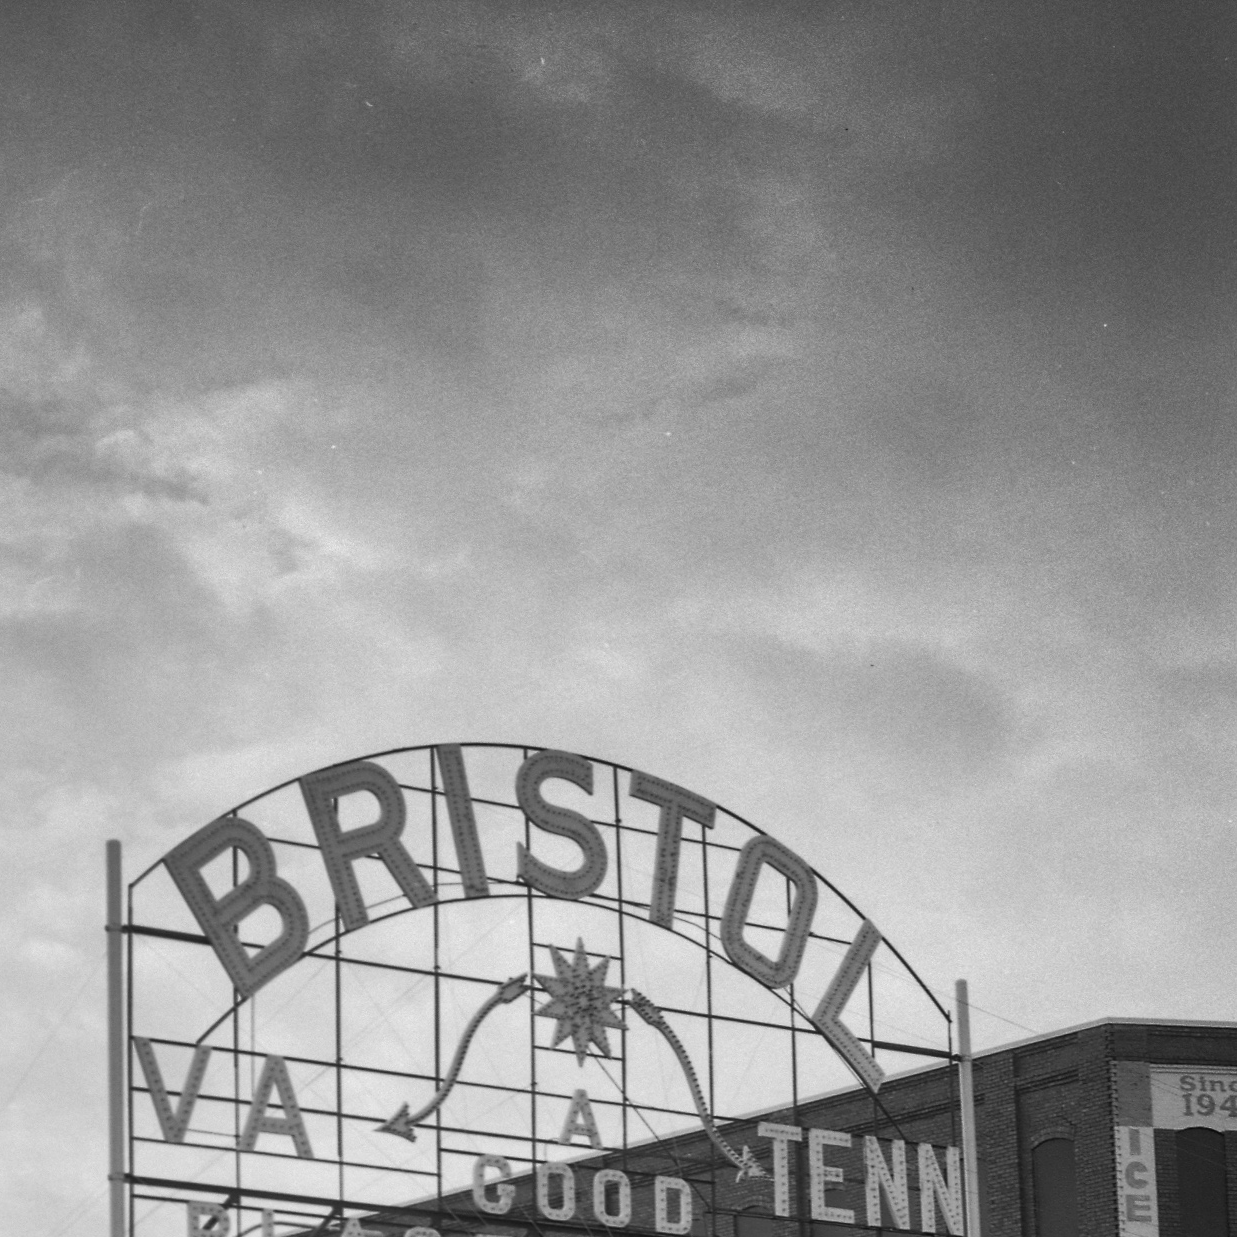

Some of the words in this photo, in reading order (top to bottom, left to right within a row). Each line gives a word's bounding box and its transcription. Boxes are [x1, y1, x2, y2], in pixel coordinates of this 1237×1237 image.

[162, 743, 885, 1092] BRISTOL
[133, 1036, 314, 1159] VA
[562, 1089, 602, 1149] A
[472, 1153, 693, 1235] GOOD
[758, 1121, 964, 1236] TENN
[1125, 1128, 1152, 1222] ICE
